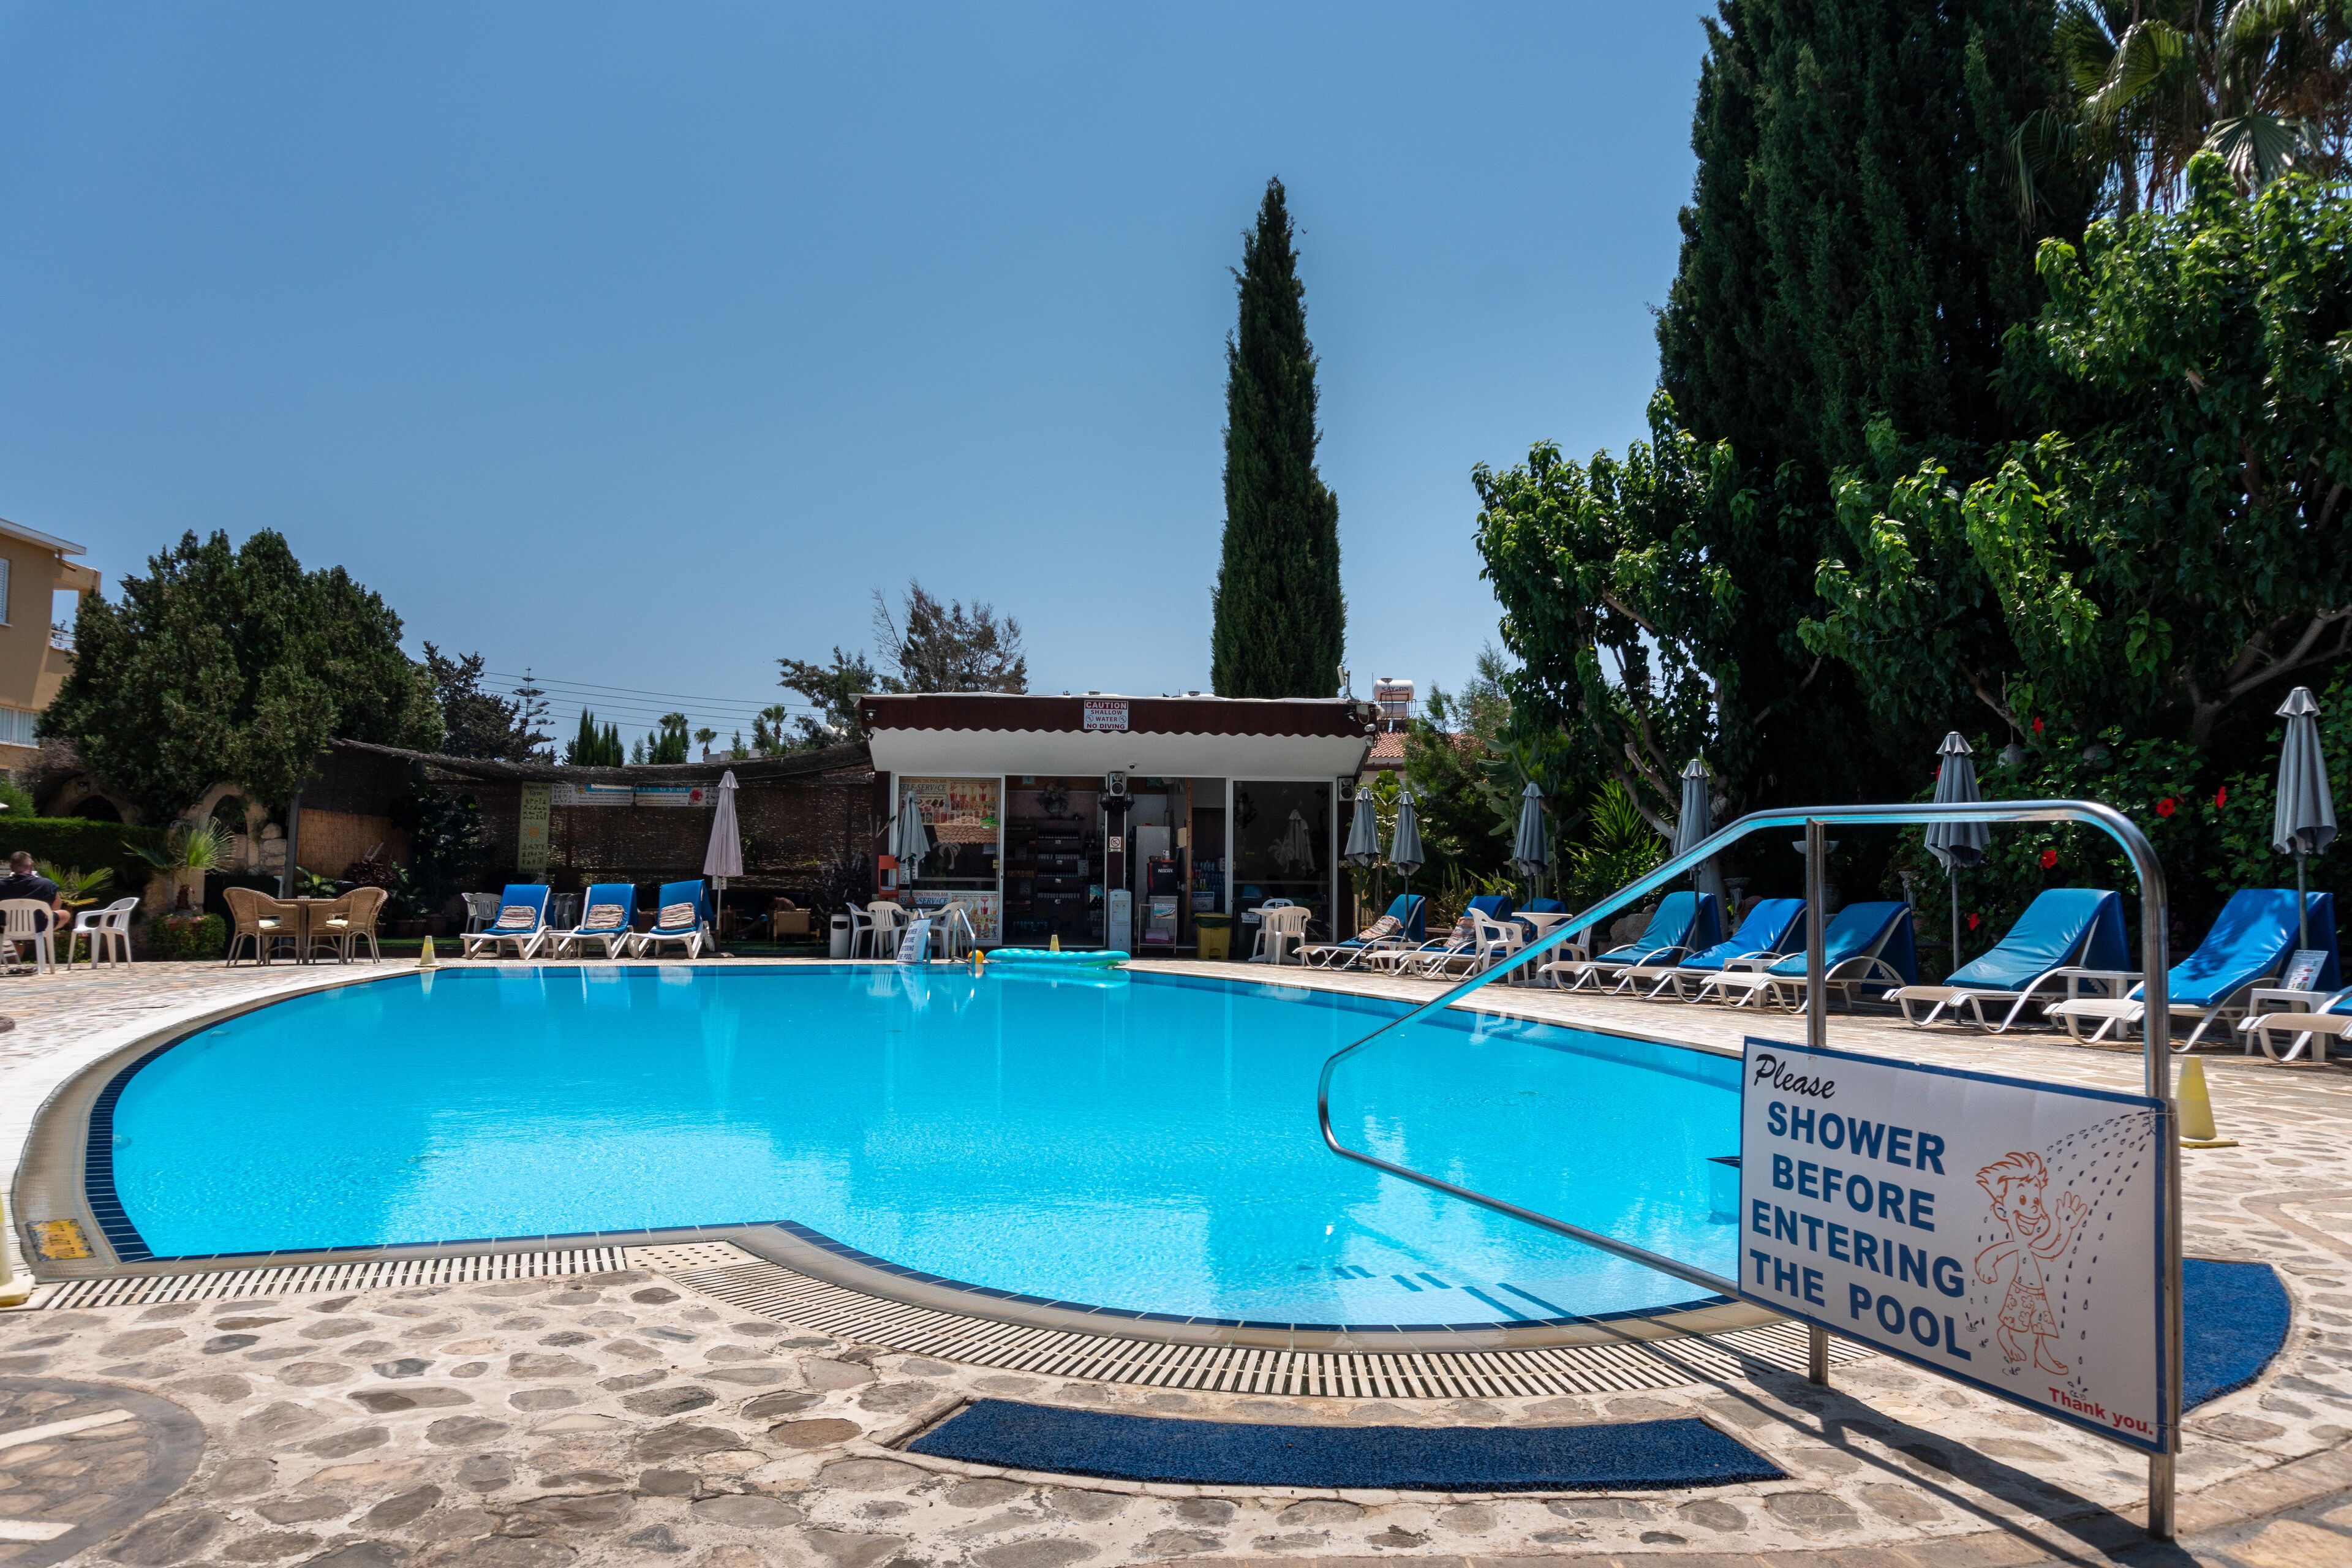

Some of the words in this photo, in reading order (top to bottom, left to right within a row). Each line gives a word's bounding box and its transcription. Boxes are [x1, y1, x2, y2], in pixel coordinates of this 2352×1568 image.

[1754, 1054, 1835, 1099] Please
[1767, 1101, 1946, 1175] SHOWER
[1773, 1153, 1935, 1232] BEFORE
[1752, 1198, 1964, 1298] ENTERING
[1749, 1248, 1825, 1308] THE
[1849, 1283, 1972, 1362] POOL
[2048, 1387, 2107, 1420] Thank
[2112, 1412, 2154, 1436] you.
